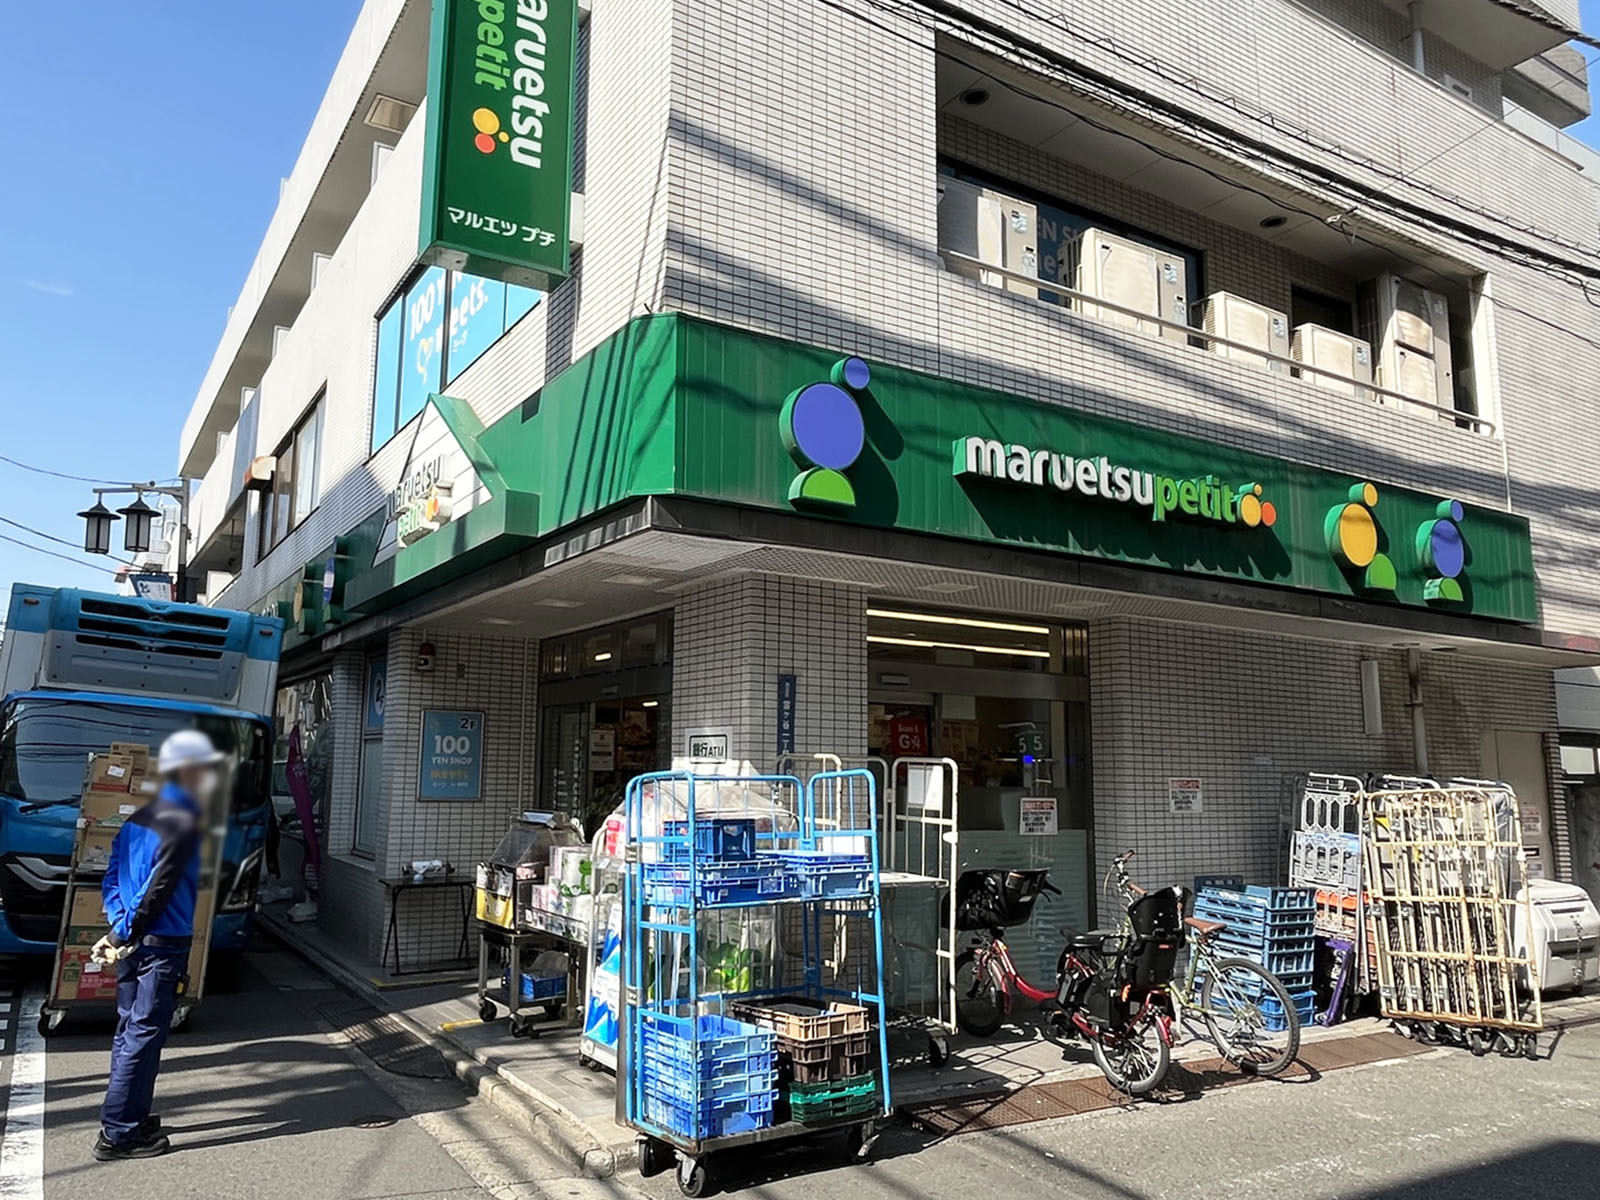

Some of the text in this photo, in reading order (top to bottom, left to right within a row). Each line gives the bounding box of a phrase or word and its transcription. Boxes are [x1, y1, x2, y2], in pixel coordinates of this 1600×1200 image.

[474, 0, 511, 91] petit
[410, 282, 436, 341] 100
[966, 436, 1236, 522] maruetsu petit
[434, 735, 470, 755] 100
[460, 717, 477, 730] 2F
